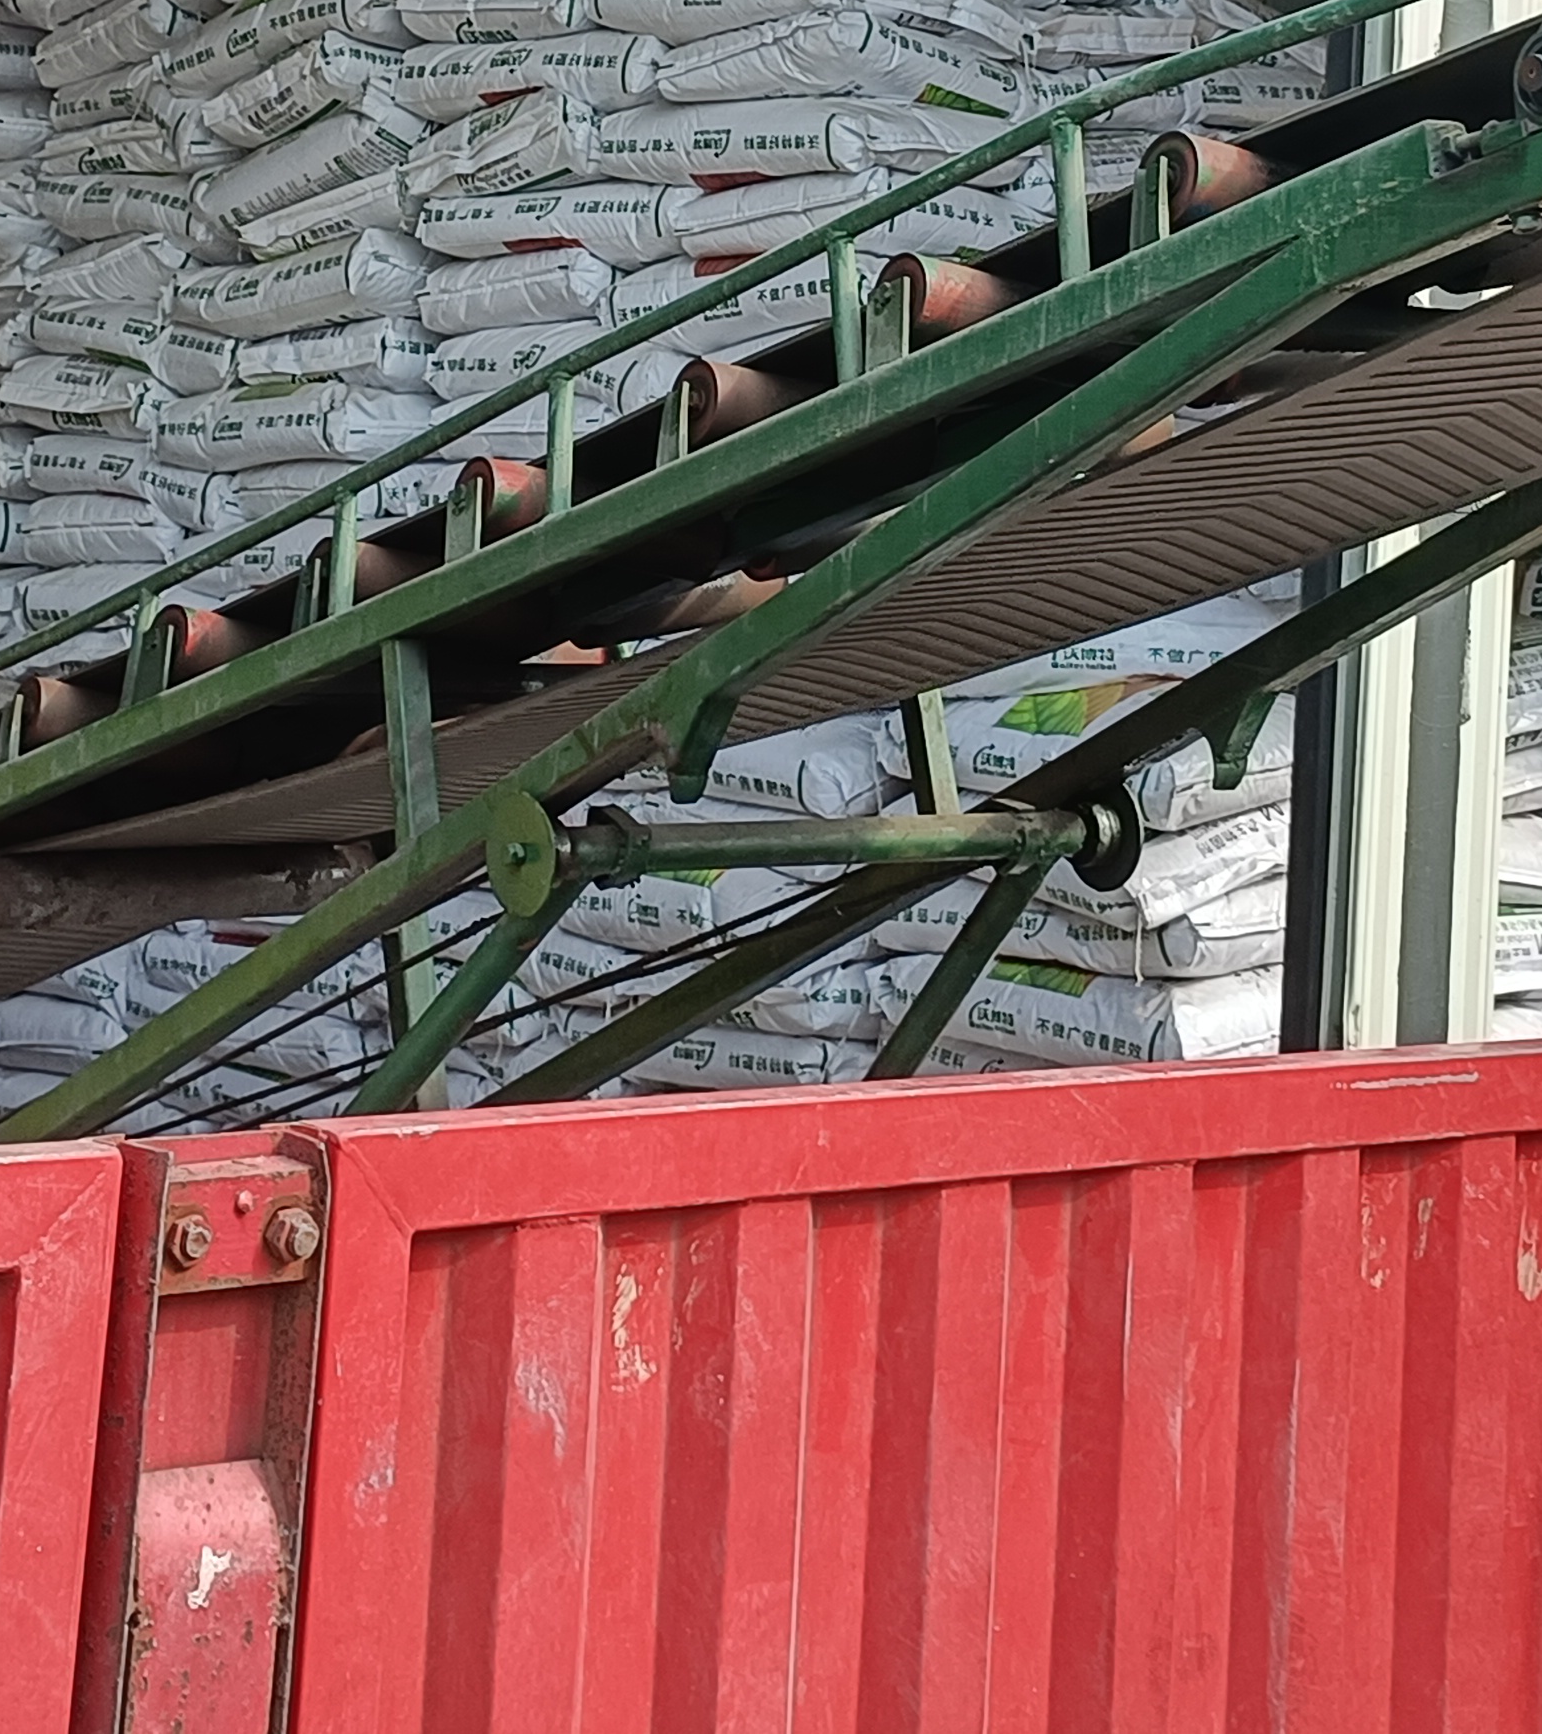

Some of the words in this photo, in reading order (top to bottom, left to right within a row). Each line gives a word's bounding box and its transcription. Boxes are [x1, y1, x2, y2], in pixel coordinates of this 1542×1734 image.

[1035, 1018, 1144, 1060] 不做广告看肥效
